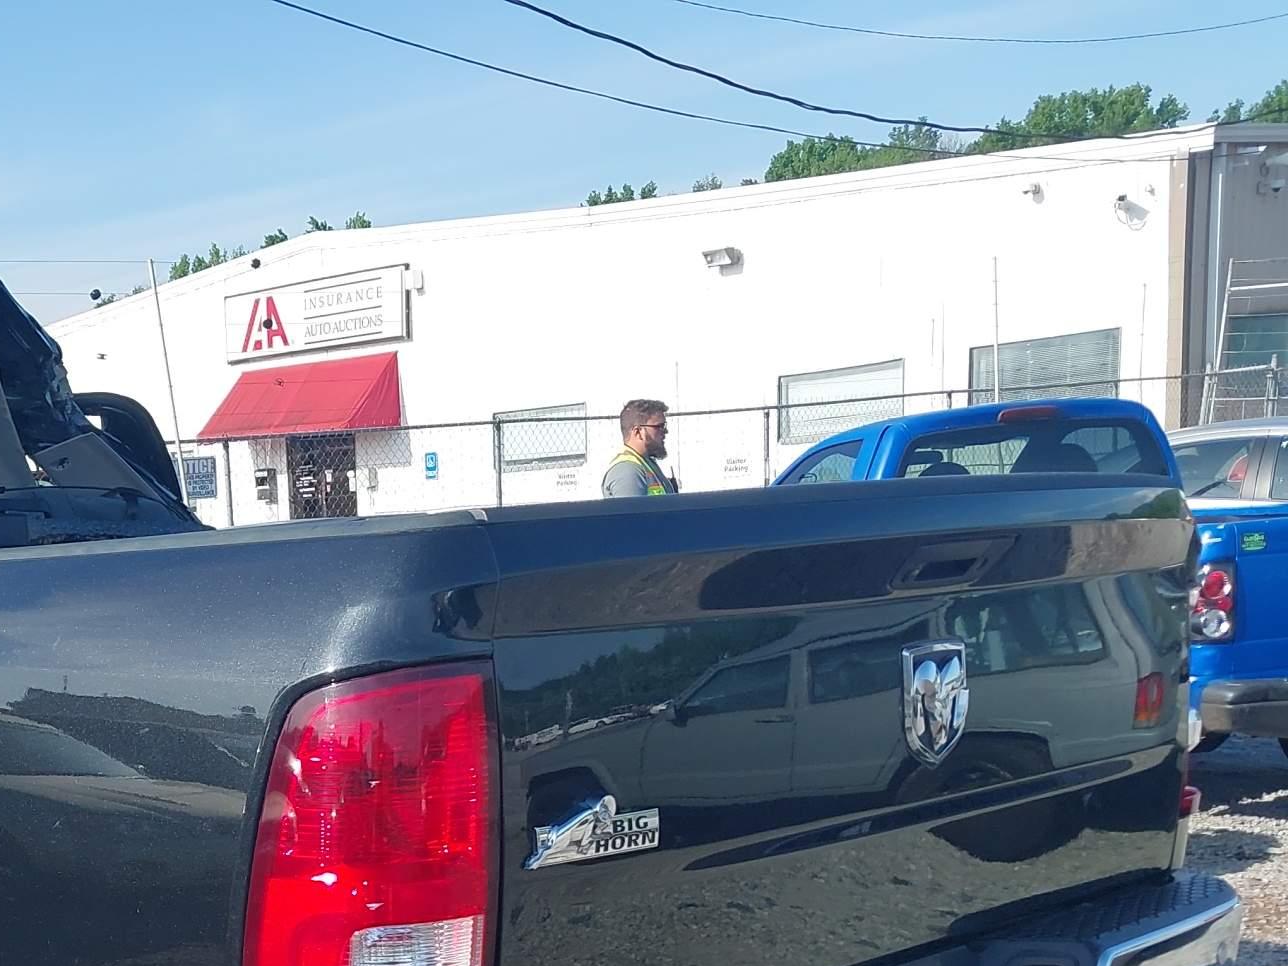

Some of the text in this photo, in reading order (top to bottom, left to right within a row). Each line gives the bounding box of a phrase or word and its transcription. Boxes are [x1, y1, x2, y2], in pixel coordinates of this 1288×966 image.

[303, 285, 383, 311] INSURANCE
[303, 314, 384, 338] AUTO AUCTIONS
[612, 815, 649, 834] BIG
[594, 828, 658, 853] HORN
